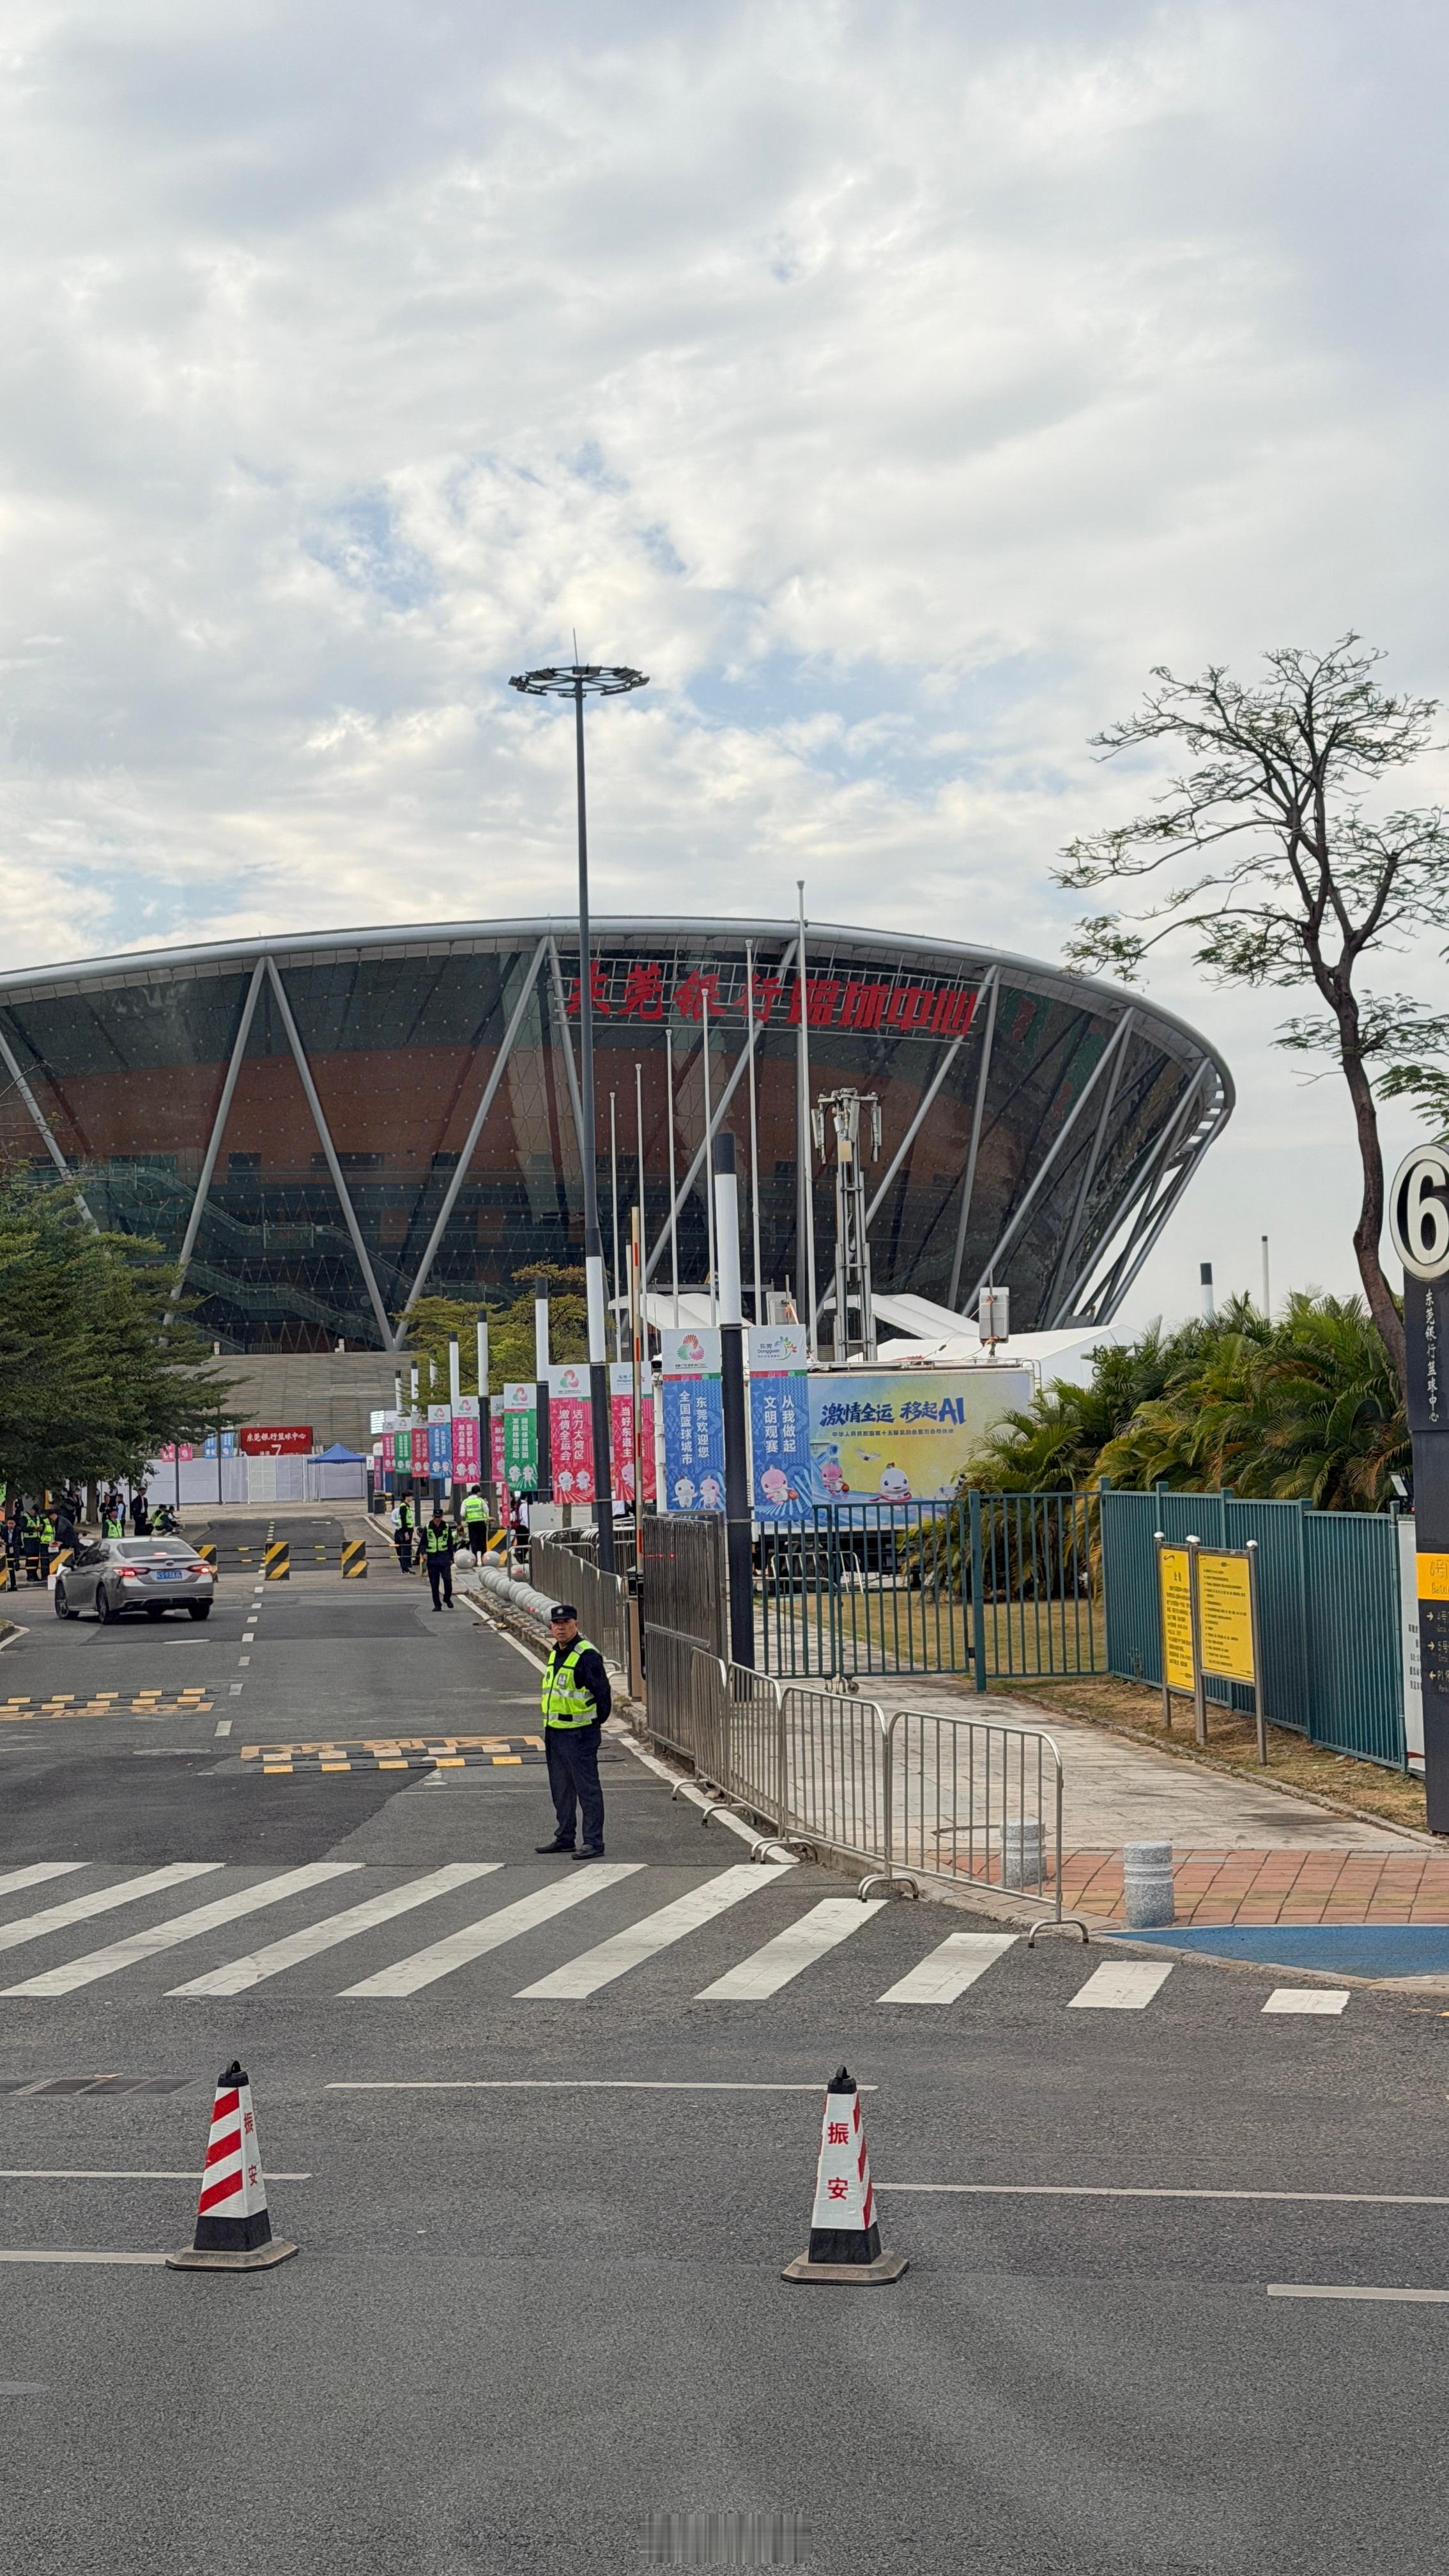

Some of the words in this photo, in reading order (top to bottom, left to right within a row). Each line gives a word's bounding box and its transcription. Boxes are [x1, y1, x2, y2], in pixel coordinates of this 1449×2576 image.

[1407, 1160, 1449, 1264] 6
[1425, 1289, 1439, 1422] 东莞银行篮球中心
[247, 1432, 307, 1442] 东莞银行篮球中心
[572, 1409, 585, 1460] 活力大湾区
[620, 1406, 632, 1457] 当好东道主
[679, 1390, 693, 1465] 全国篮球城市
[696, 1397, 710, 1458] 东莞欢迎您
[764, 1396, 779, 1453] 文明观赛
[782, 1395, 796, 1452] 从我做起
[819, 1401, 894, 1427] 激情全运
[900, 1397, 967, 1426] 移起AI
[271, 1444, 282, 1455] 7
[827, 2122, 849, 2200] 振安
